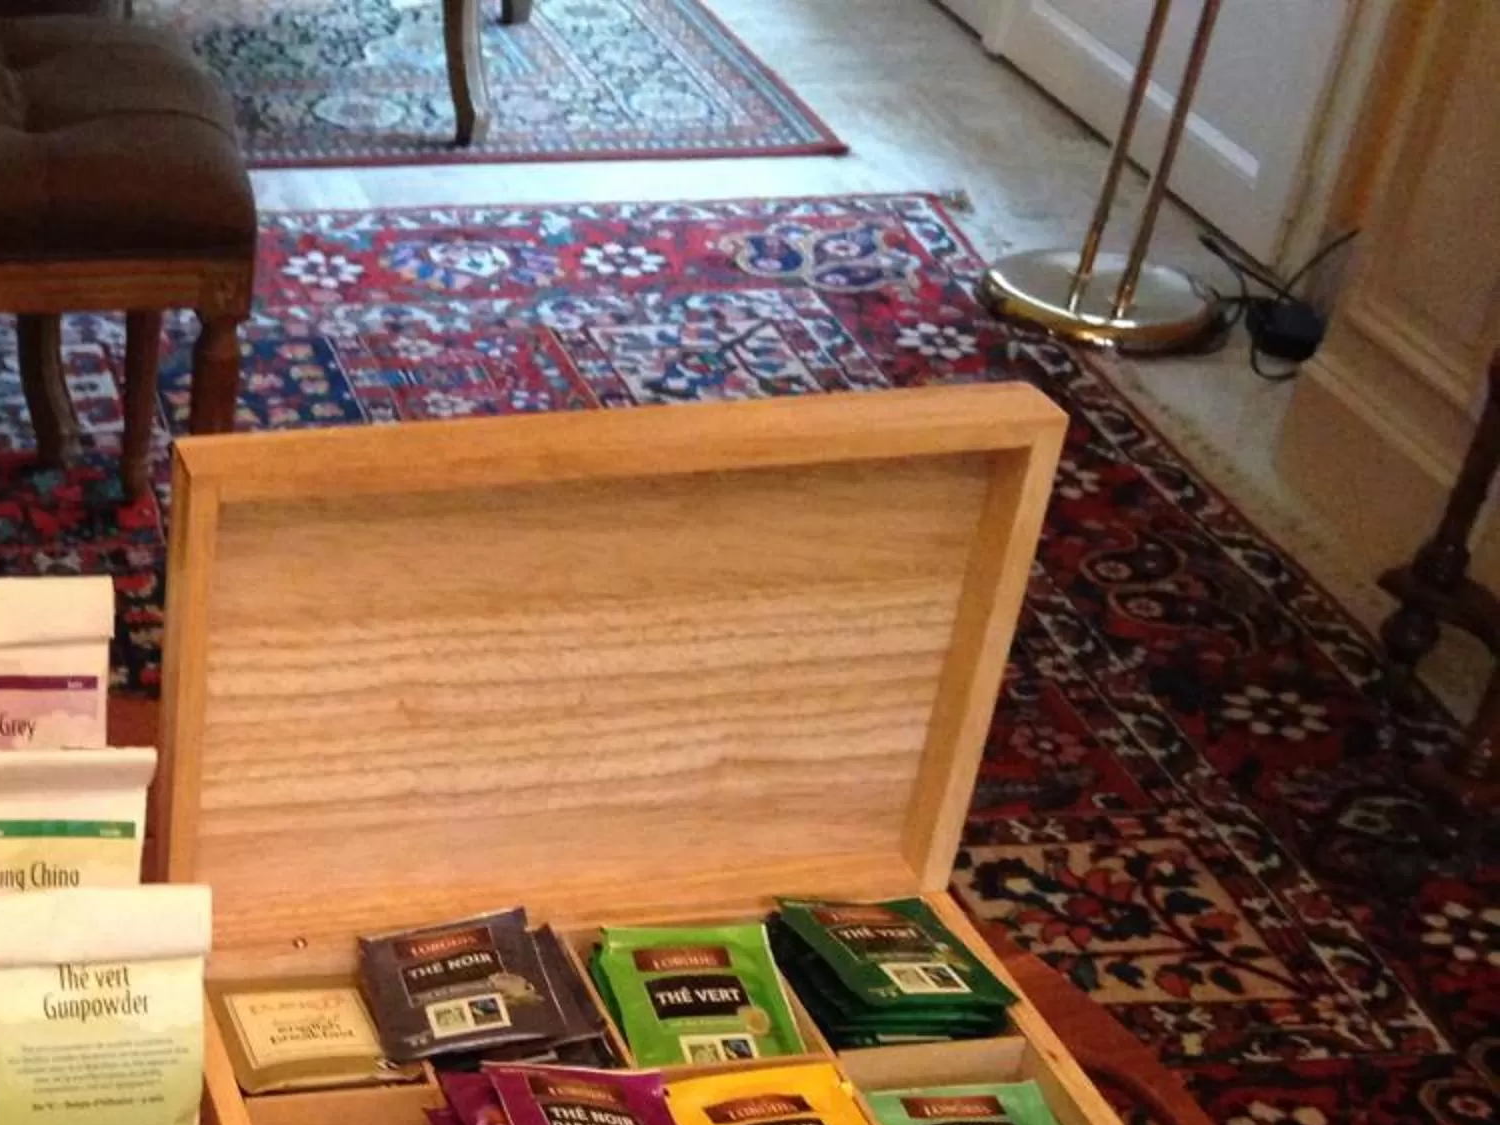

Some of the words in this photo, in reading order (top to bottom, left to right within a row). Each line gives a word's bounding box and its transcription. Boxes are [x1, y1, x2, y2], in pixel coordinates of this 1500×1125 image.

[0, 712, 36, 741] Grey
[448, 952, 493, 970] NOIR
[95, 965, 130, 988] vert
[43, 990, 148, 1021] Gunpowder
[655, 986, 693, 1006] THÉ
[694, 987, 740, 1003] VERT
